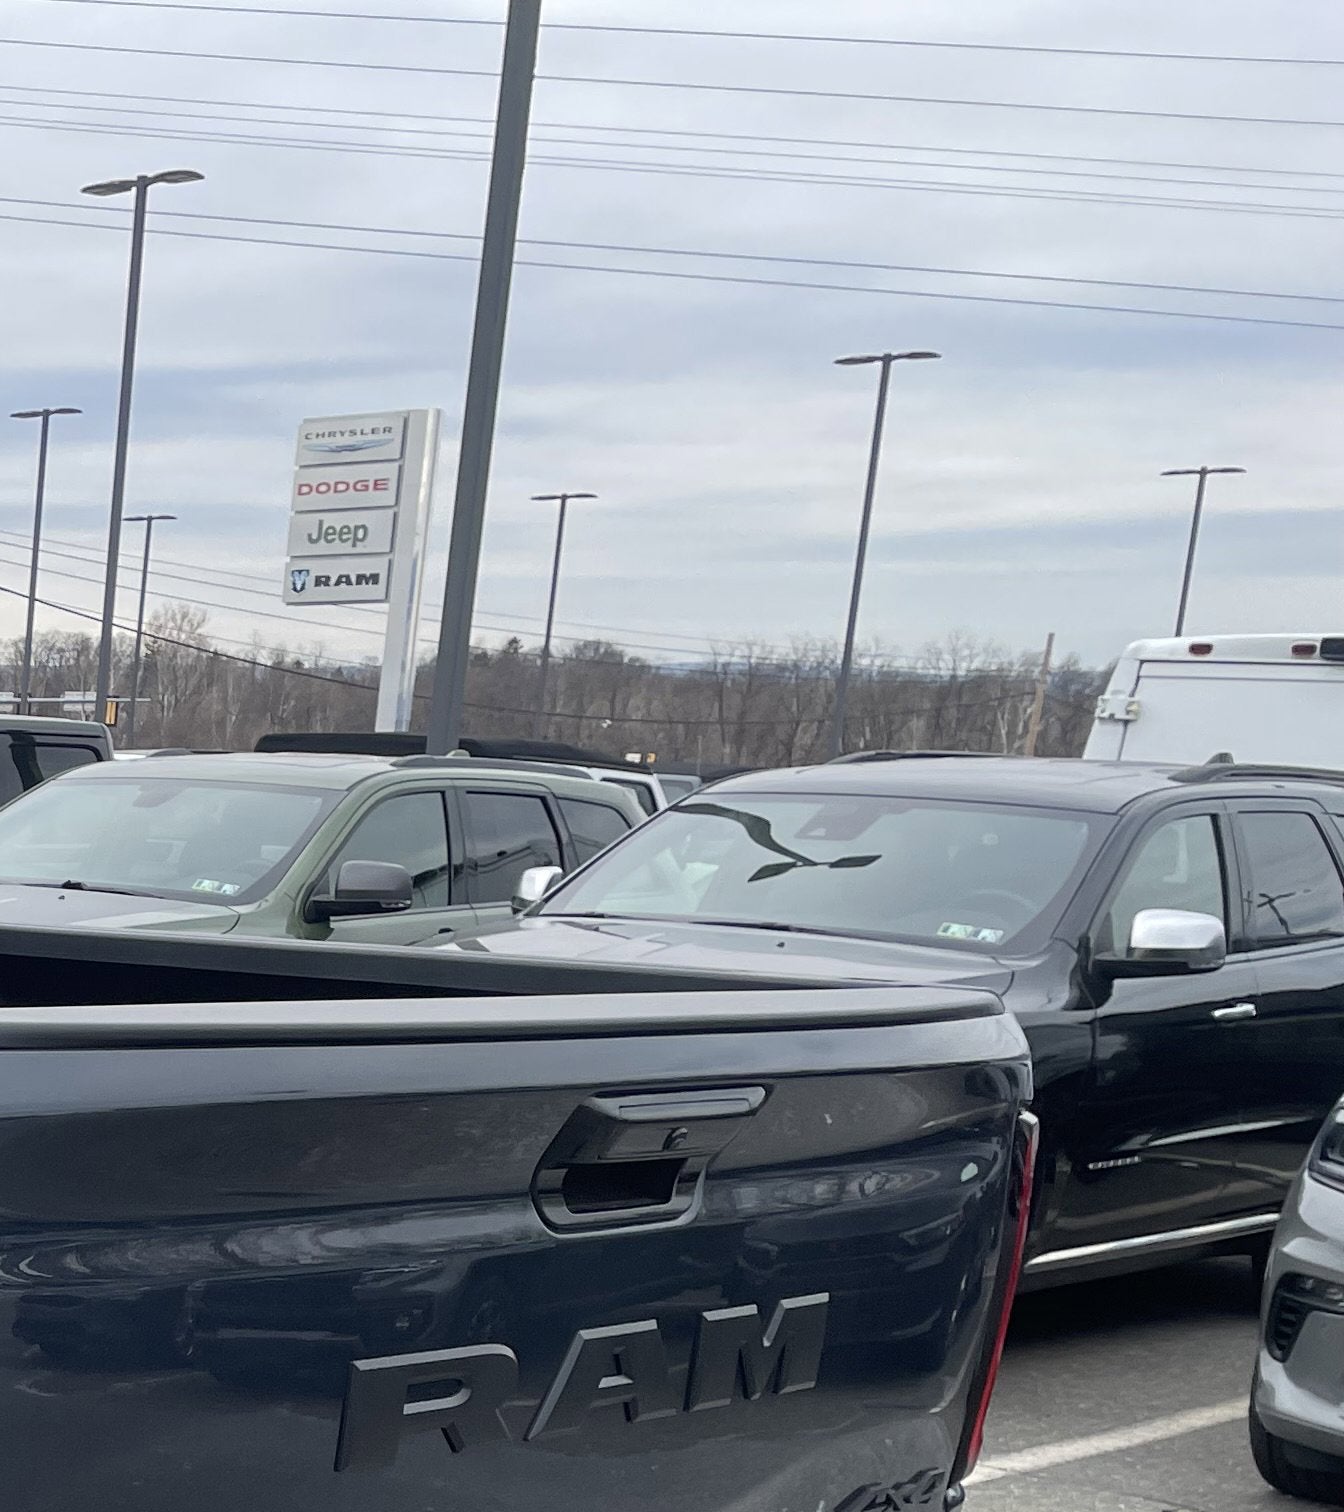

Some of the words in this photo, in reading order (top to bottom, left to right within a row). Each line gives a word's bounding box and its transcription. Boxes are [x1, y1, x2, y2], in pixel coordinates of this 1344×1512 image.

[304, 426, 393, 440] CHRYSLER
[297, 478, 390, 496] DODGE
[307, 519, 368, 547] Jeep
[314, 573, 380, 587] RAM
[333, 1292, 830, 1472] RAM
